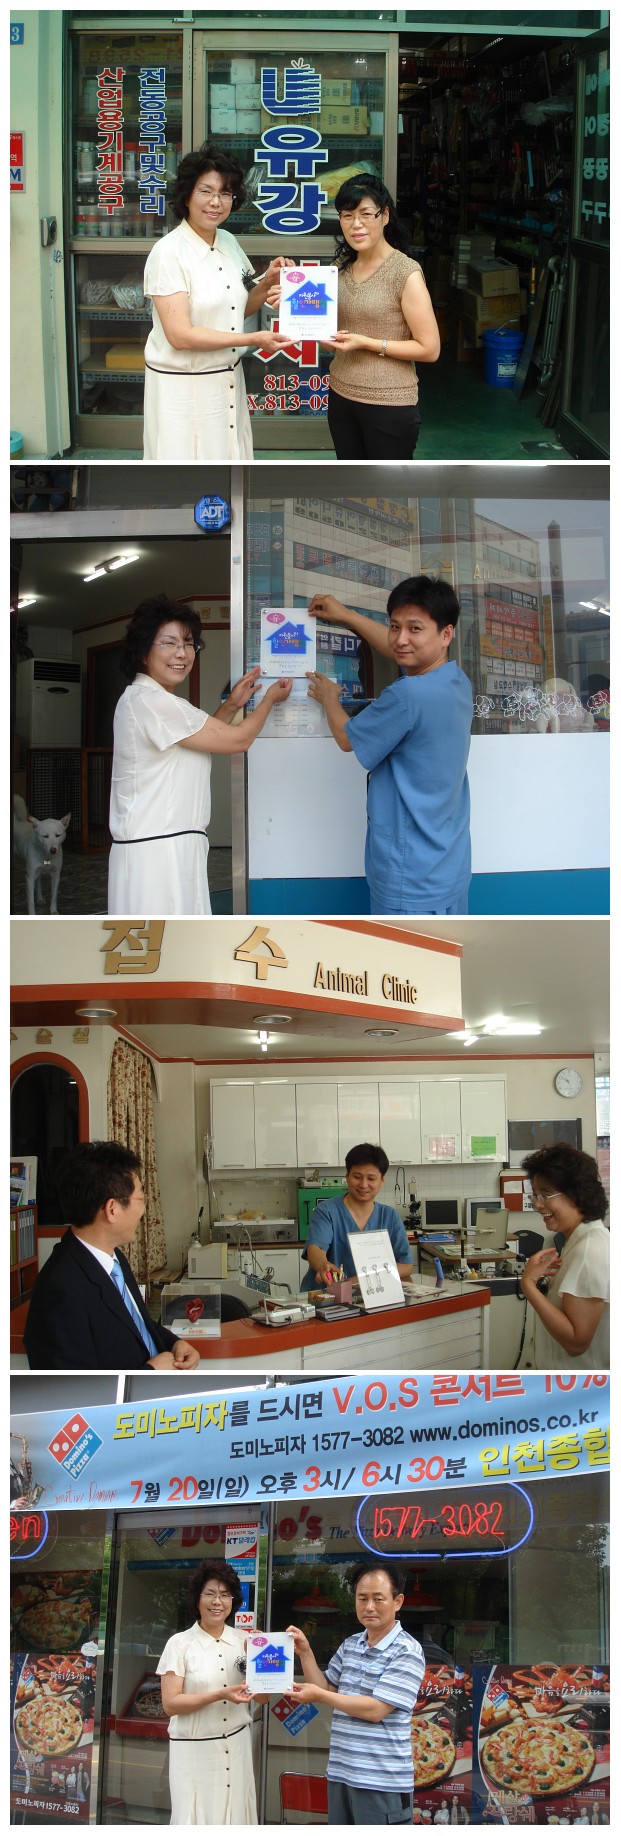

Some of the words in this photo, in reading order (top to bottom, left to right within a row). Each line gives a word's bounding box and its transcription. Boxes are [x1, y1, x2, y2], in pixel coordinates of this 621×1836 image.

[96, 67, 125, 216] 산업용기계공구
[138, 68, 167, 216] 전동공구및수리
[252, 124, 329, 235] 유강
[200, 505, 225, 519] ADT
[314, 961, 369, 997] Animal
[381, 973, 418, 1004] Clinic
[112, 1399, 250, 1440] 도미노피자를
[257, 1391, 323, 1422] 드시면
[332, 1377, 420, 1415] V.O.S
[430, 1375, 526, 1407] 콘서트
[63, 1432, 94, 1471] Domino's
[230, 1434, 306, 1459] 도미노피자
[312, 1426, 405, 1452] 1577-3082
[410, 1409, 598, 1443] www.dominos.co.kr
[70, 1453, 91, 1478] Pizza
[130, 1480, 161, 1503] 7월
[166, 1474, 250, 1502] 20일(일)
[256, 1472, 298, 1495] 오후
[361, 1461, 402, 1488] 6시
[406, 1455, 468, 1483] 30분
[479, 1425, 610, 1478] 인천종합
[373, 1502, 506, 1539] 1577-3082
[291, 1719, 306, 1734] Pizza
[16, 1797, 45, 1809] 도미노피자
[46, 1801, 80, 1814] 1577-3082
